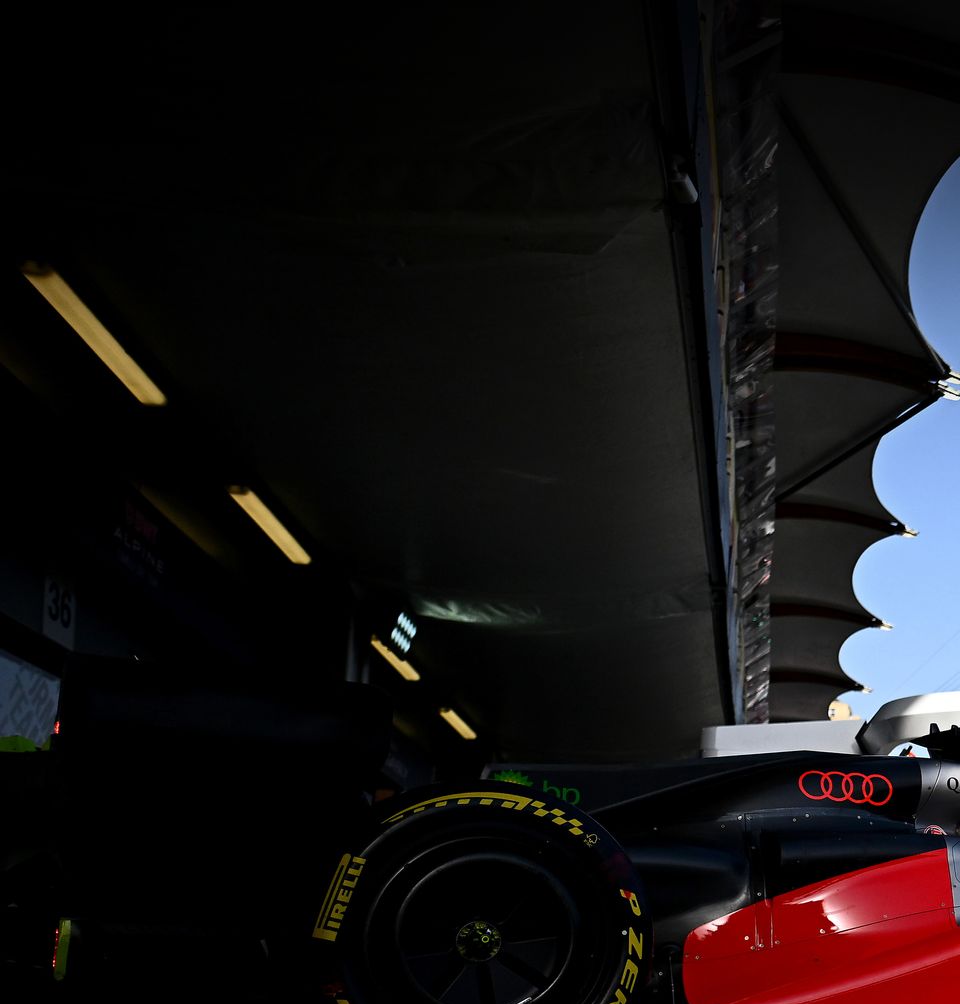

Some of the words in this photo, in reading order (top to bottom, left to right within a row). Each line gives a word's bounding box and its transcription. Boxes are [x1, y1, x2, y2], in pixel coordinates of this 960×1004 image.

[48, 581, 71, 628] 36
[542, 776, 583, 806] bp
[312, 852, 366, 942] PIRELLI
